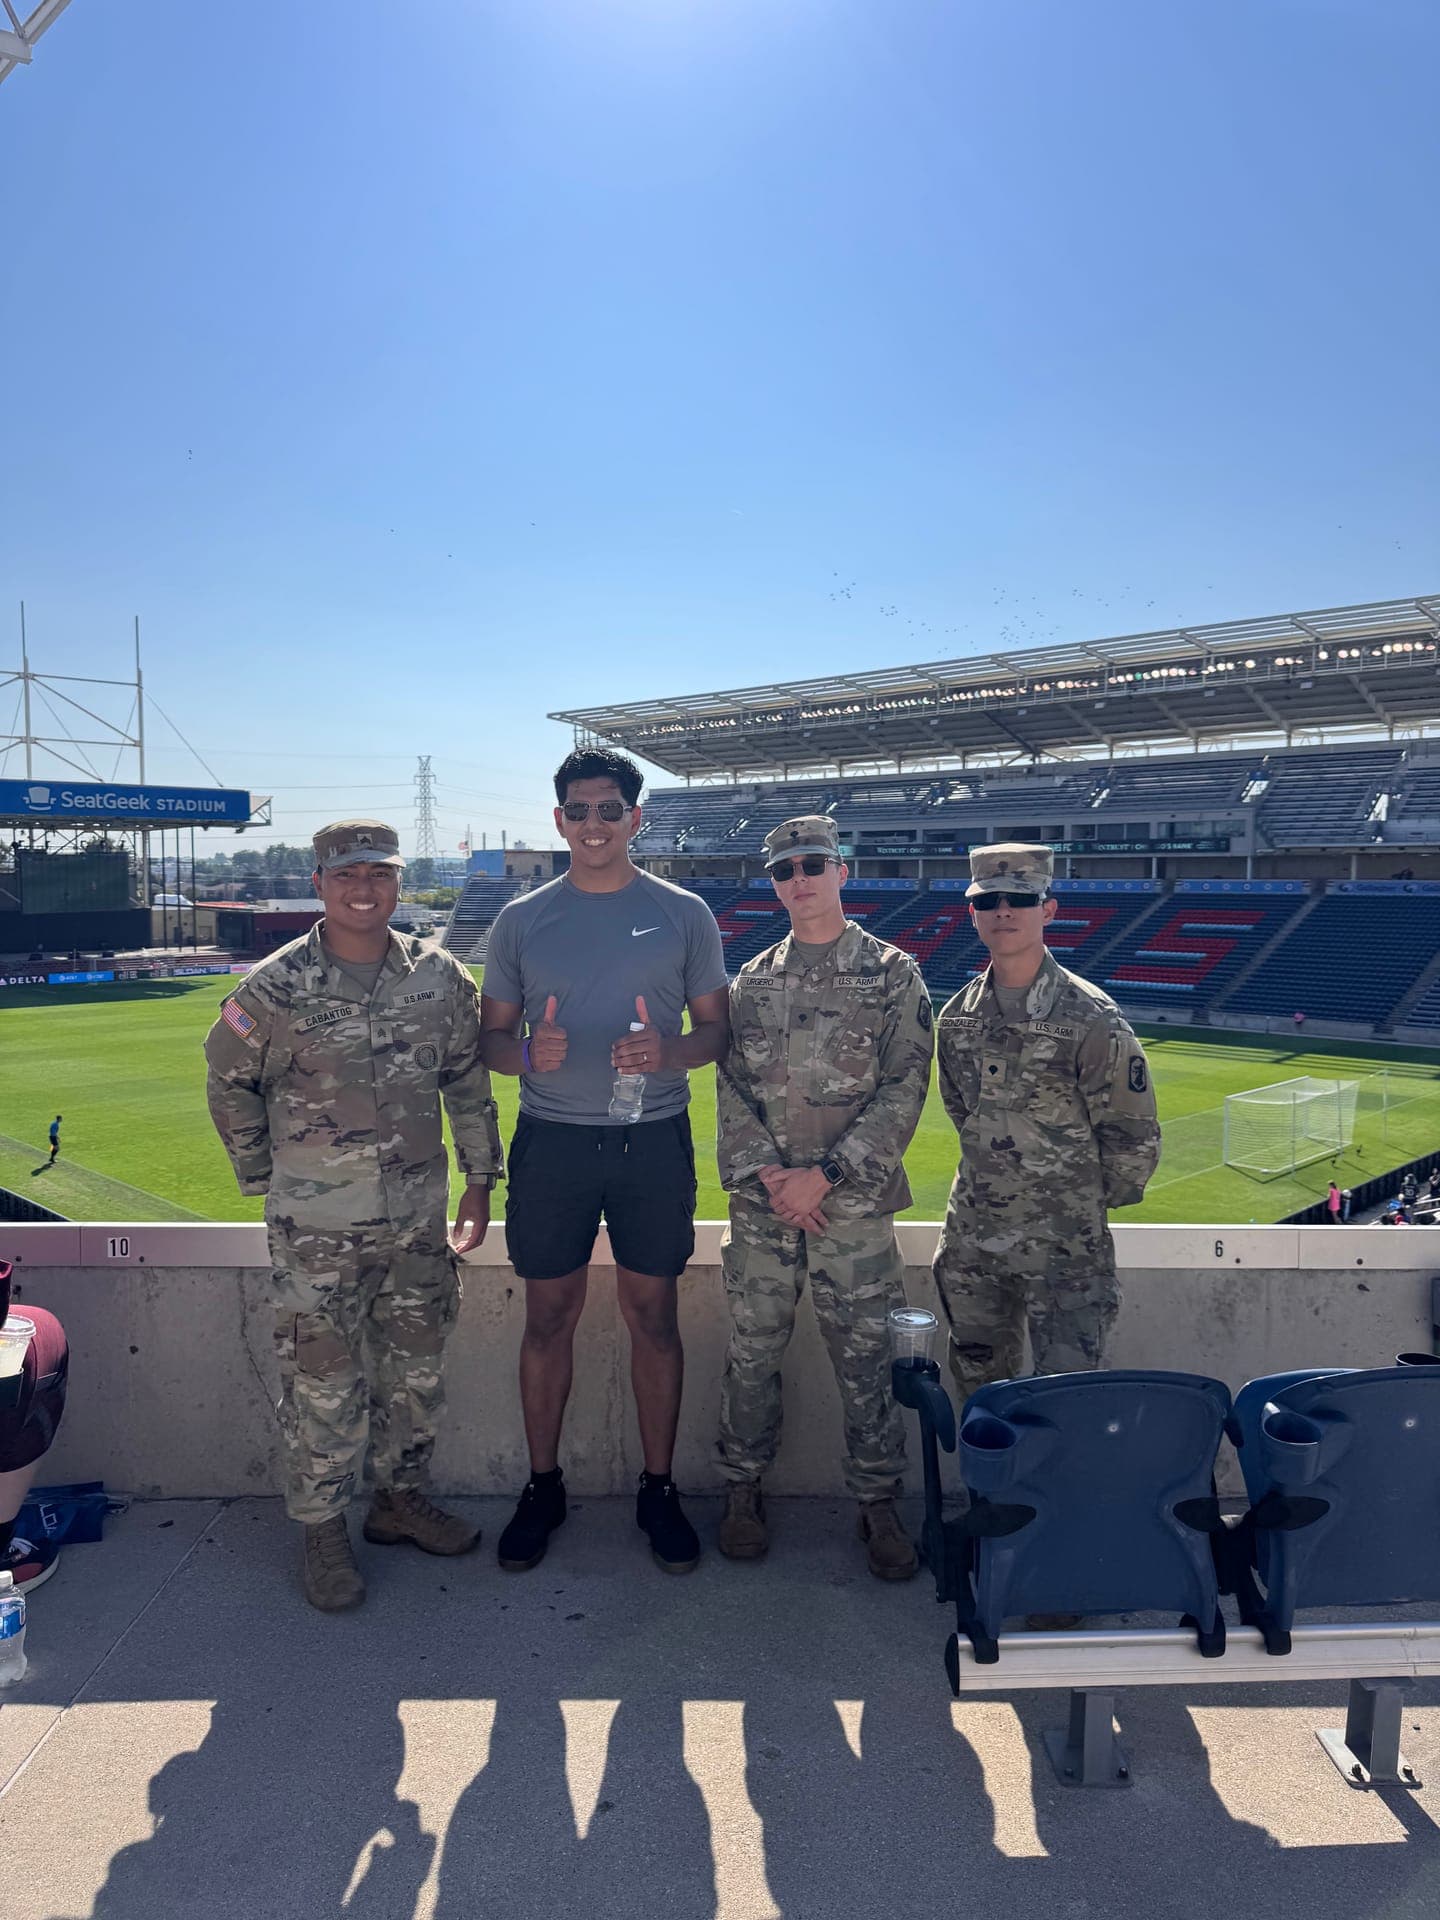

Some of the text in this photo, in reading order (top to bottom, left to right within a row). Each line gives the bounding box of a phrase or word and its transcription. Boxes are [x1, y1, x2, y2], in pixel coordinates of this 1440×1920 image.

[61, 791, 226, 813] SeatGeek STADIUM
[9, 975, 46, 985] DELTA
[855, 976, 879, 986] ARMY
[416, 991, 436, 1001] ARMY
[305, 1006, 353, 1028] CABANTOG
[1054, 1026, 1075, 1037] ARM
[109, 1238, 129, 1257] 10
[1215, 1240, 1224, 1258] 6
